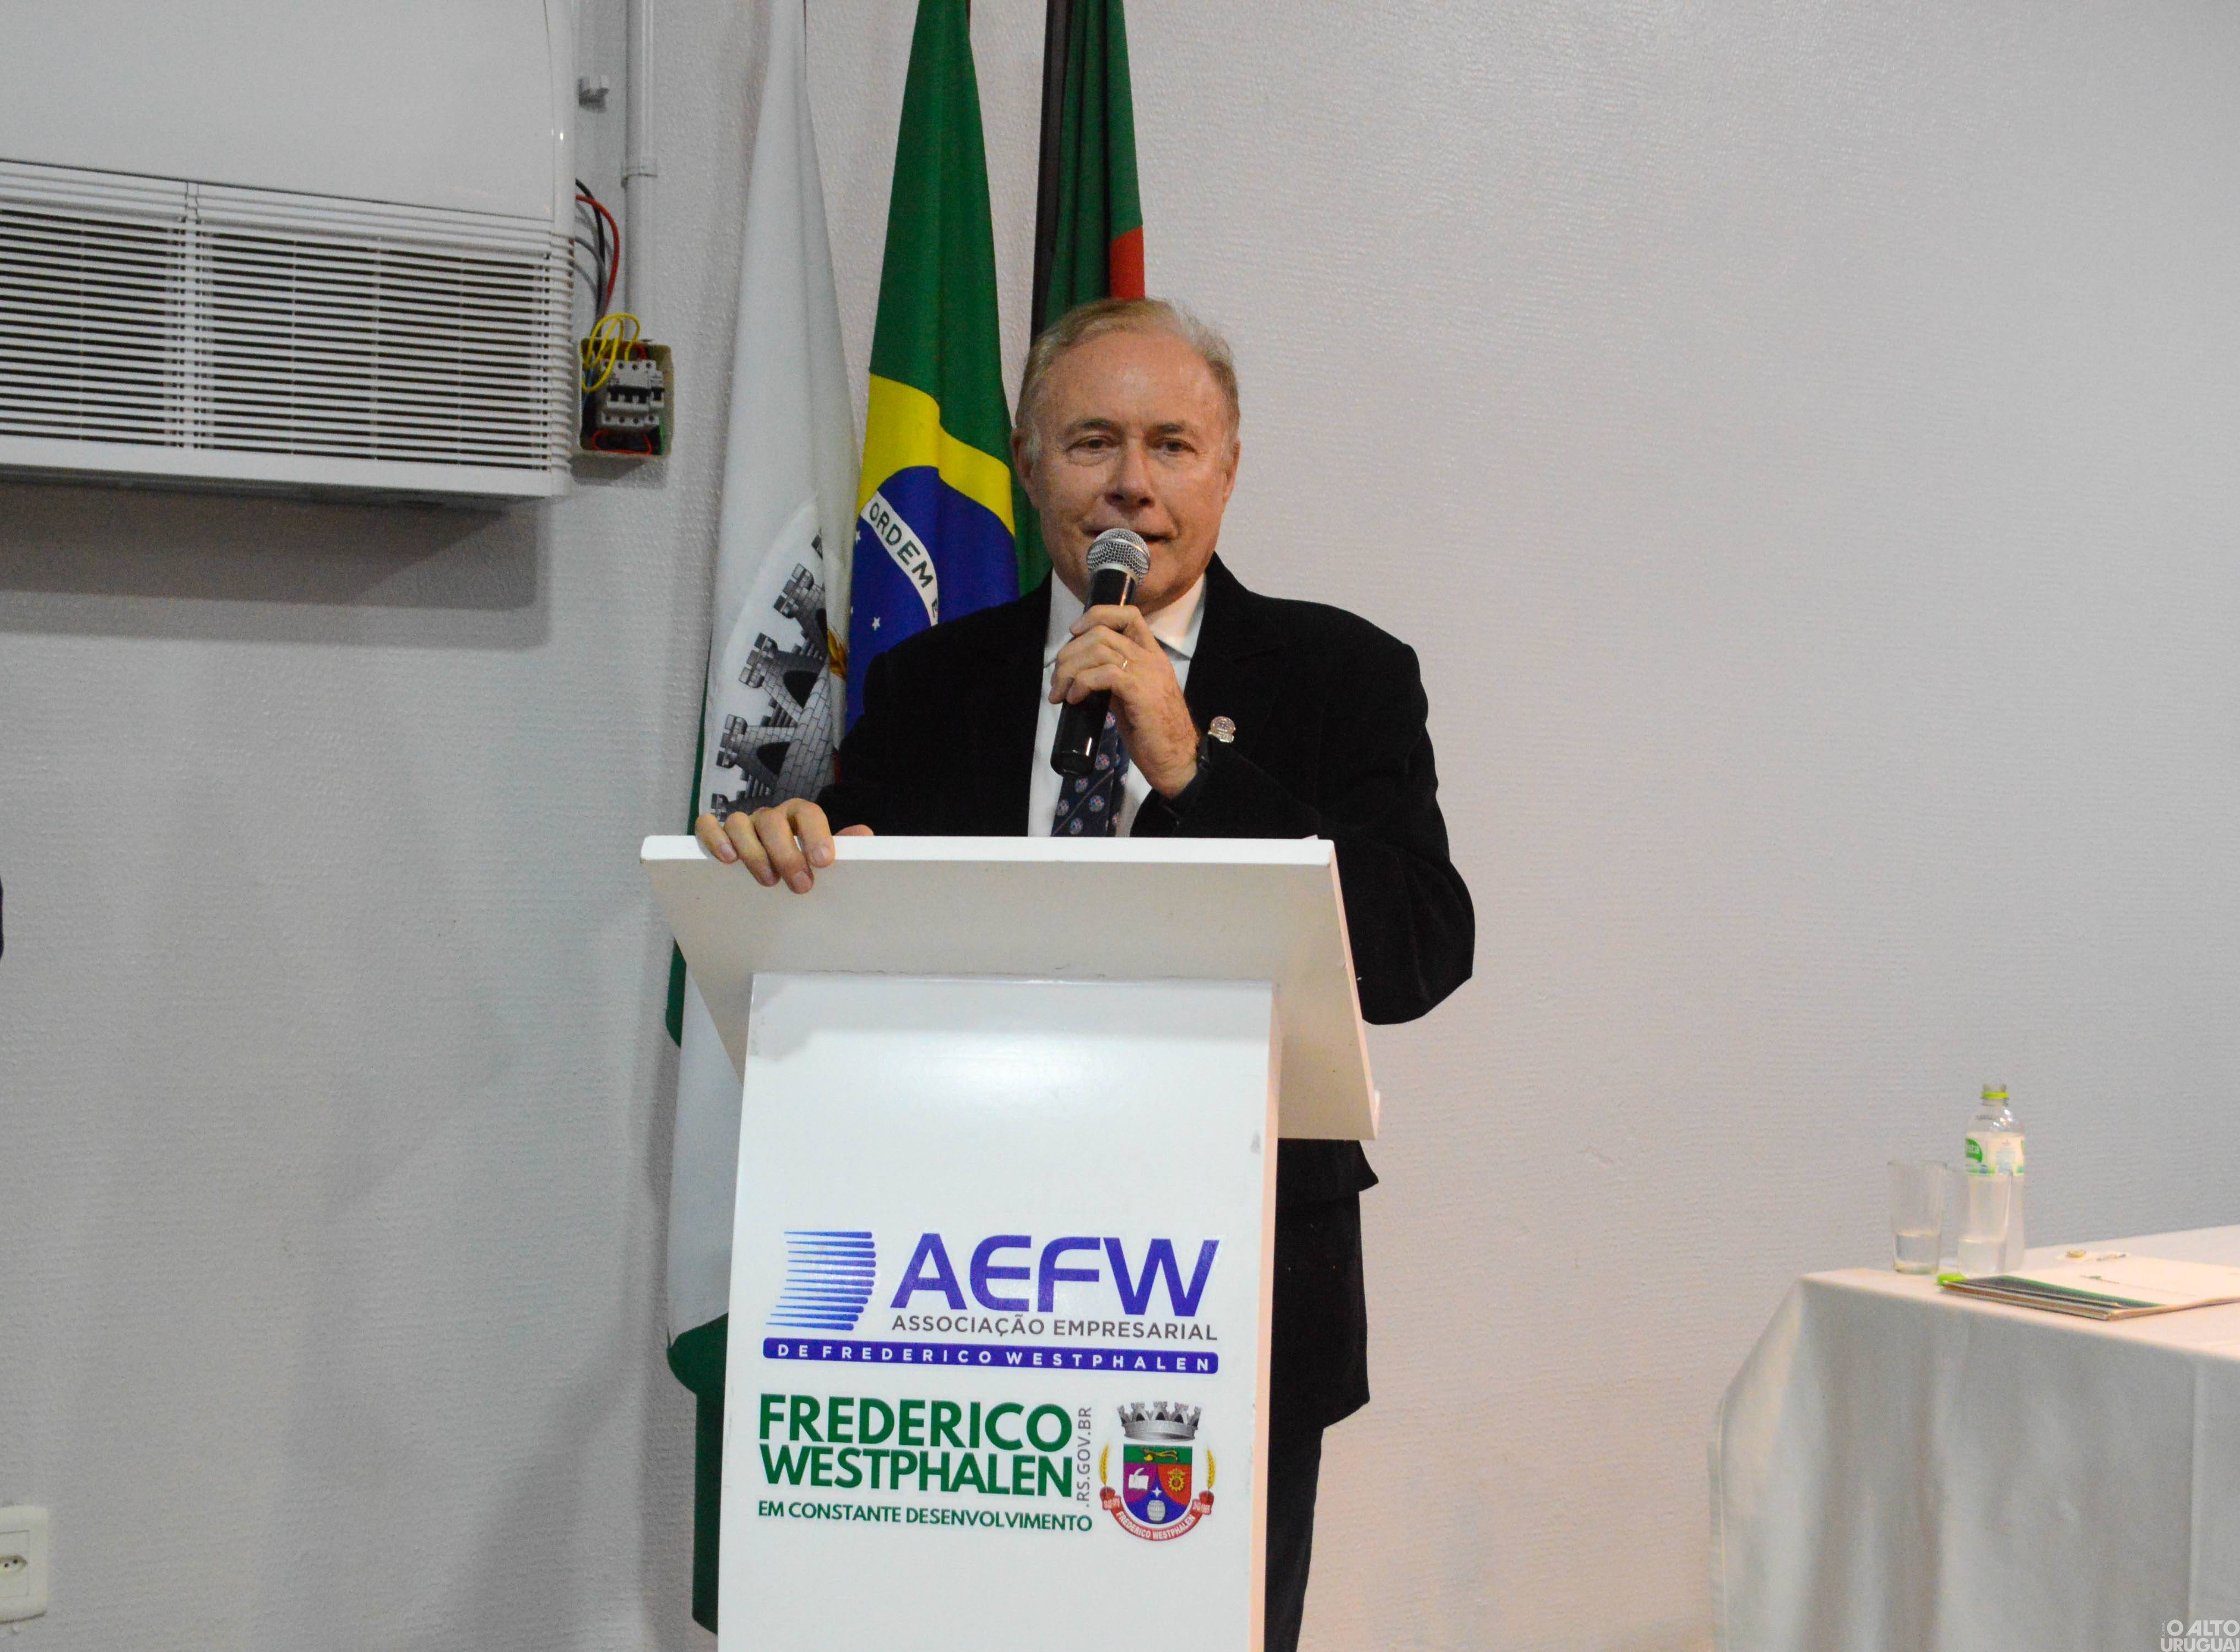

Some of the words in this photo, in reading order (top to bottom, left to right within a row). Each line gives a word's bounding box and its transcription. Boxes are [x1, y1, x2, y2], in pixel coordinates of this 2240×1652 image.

[869, 502, 934, 589] ORDEM
[890, 1232, 1220, 1317] AEFW
[892, 1313, 1045, 1337] ASSOCIAÇÃO
[1053, 1319, 1218, 1341] EMPRESARIAL
[1006, 1351, 1210, 1371] WESTPHALEN
[759, 1393, 1073, 1451] FREDERICO
[760, 1444, 1073, 1498] WESTPHALEN
[758, 1501, 784, 1517] EM
[788, 1502, 901, 1523] CONSTANTE
[905, 1507, 1093, 1532] DESENVOLVIMENTO
[1116, 1510, 1151, 1539] FREDERICO
[1152, 1514, 1196, 1540] WESTPHALEN
